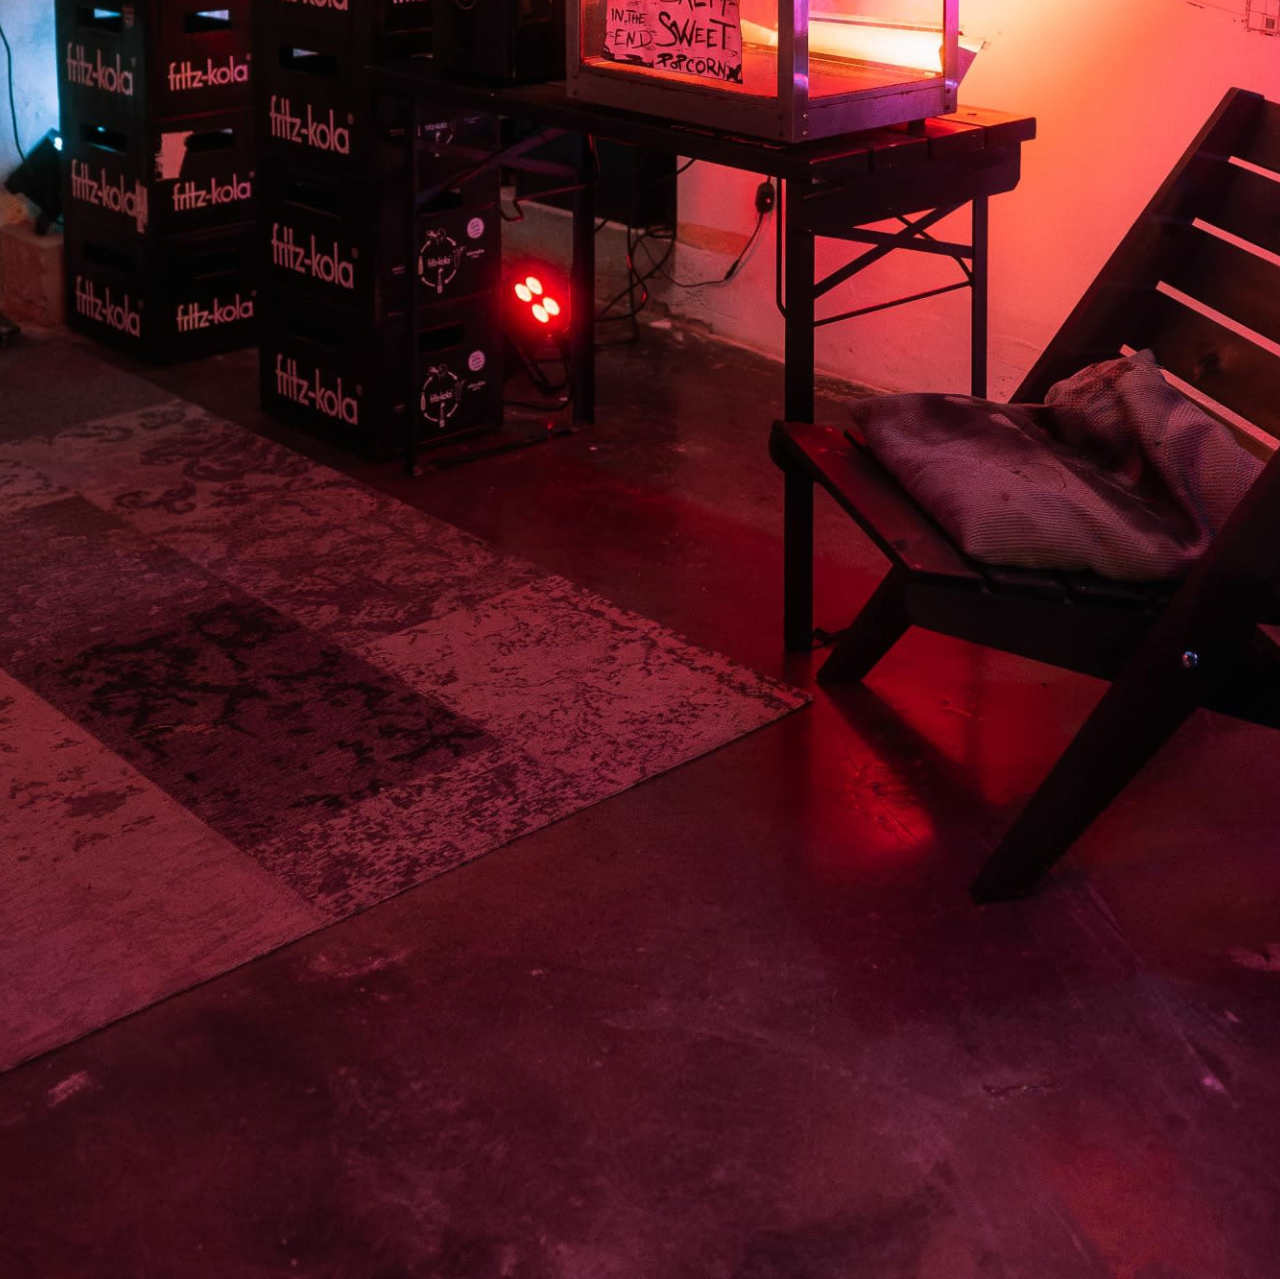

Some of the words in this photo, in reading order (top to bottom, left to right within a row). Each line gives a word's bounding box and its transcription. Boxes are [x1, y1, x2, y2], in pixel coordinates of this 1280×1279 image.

[655, 10, 737, 51] SWEET
[66, 42, 134, 97] fritz-kola
[168, 55, 249, 92] fritz-kola
[269, 94, 350, 155] fritz-kola
[172, 172, 252, 212] fritz-kola
[271, 222, 355, 289] fritz-kola
[76, 275, 141, 340] fritz-kola
[176, 292, 255, 334] fritz-kola
[275, 352, 360, 426] fritz-kola
